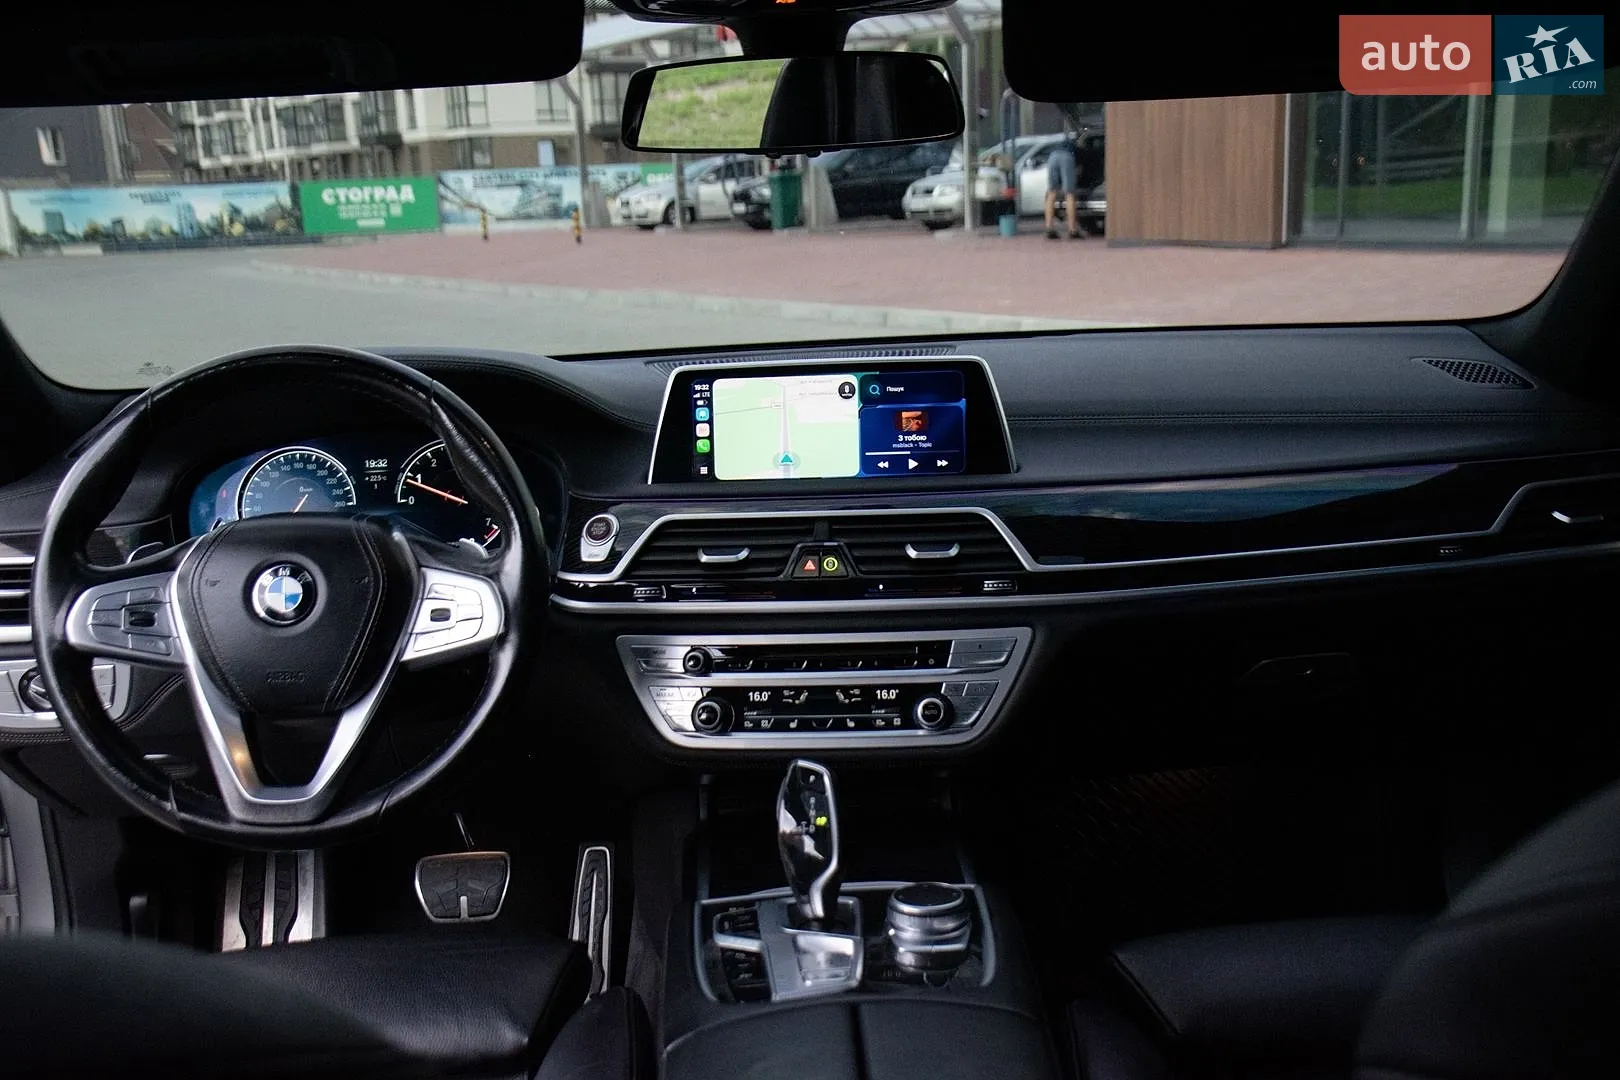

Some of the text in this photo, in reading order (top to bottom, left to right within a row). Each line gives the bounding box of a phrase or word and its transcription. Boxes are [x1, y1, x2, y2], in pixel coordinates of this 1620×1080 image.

[321, 184, 416, 206] СТОГРАД
[364, 459, 388, 468] 19:32
[431, 458, 437, 467] 2
[316, 469, 329, 477] 200
[415, 473, 422, 483] 1
[408, 495, 415, 505] 0
[485, 517, 492, 526] 7
[748, 691, 772, 702] 16.0°
[875, 689, 900, 700] 16.0°
